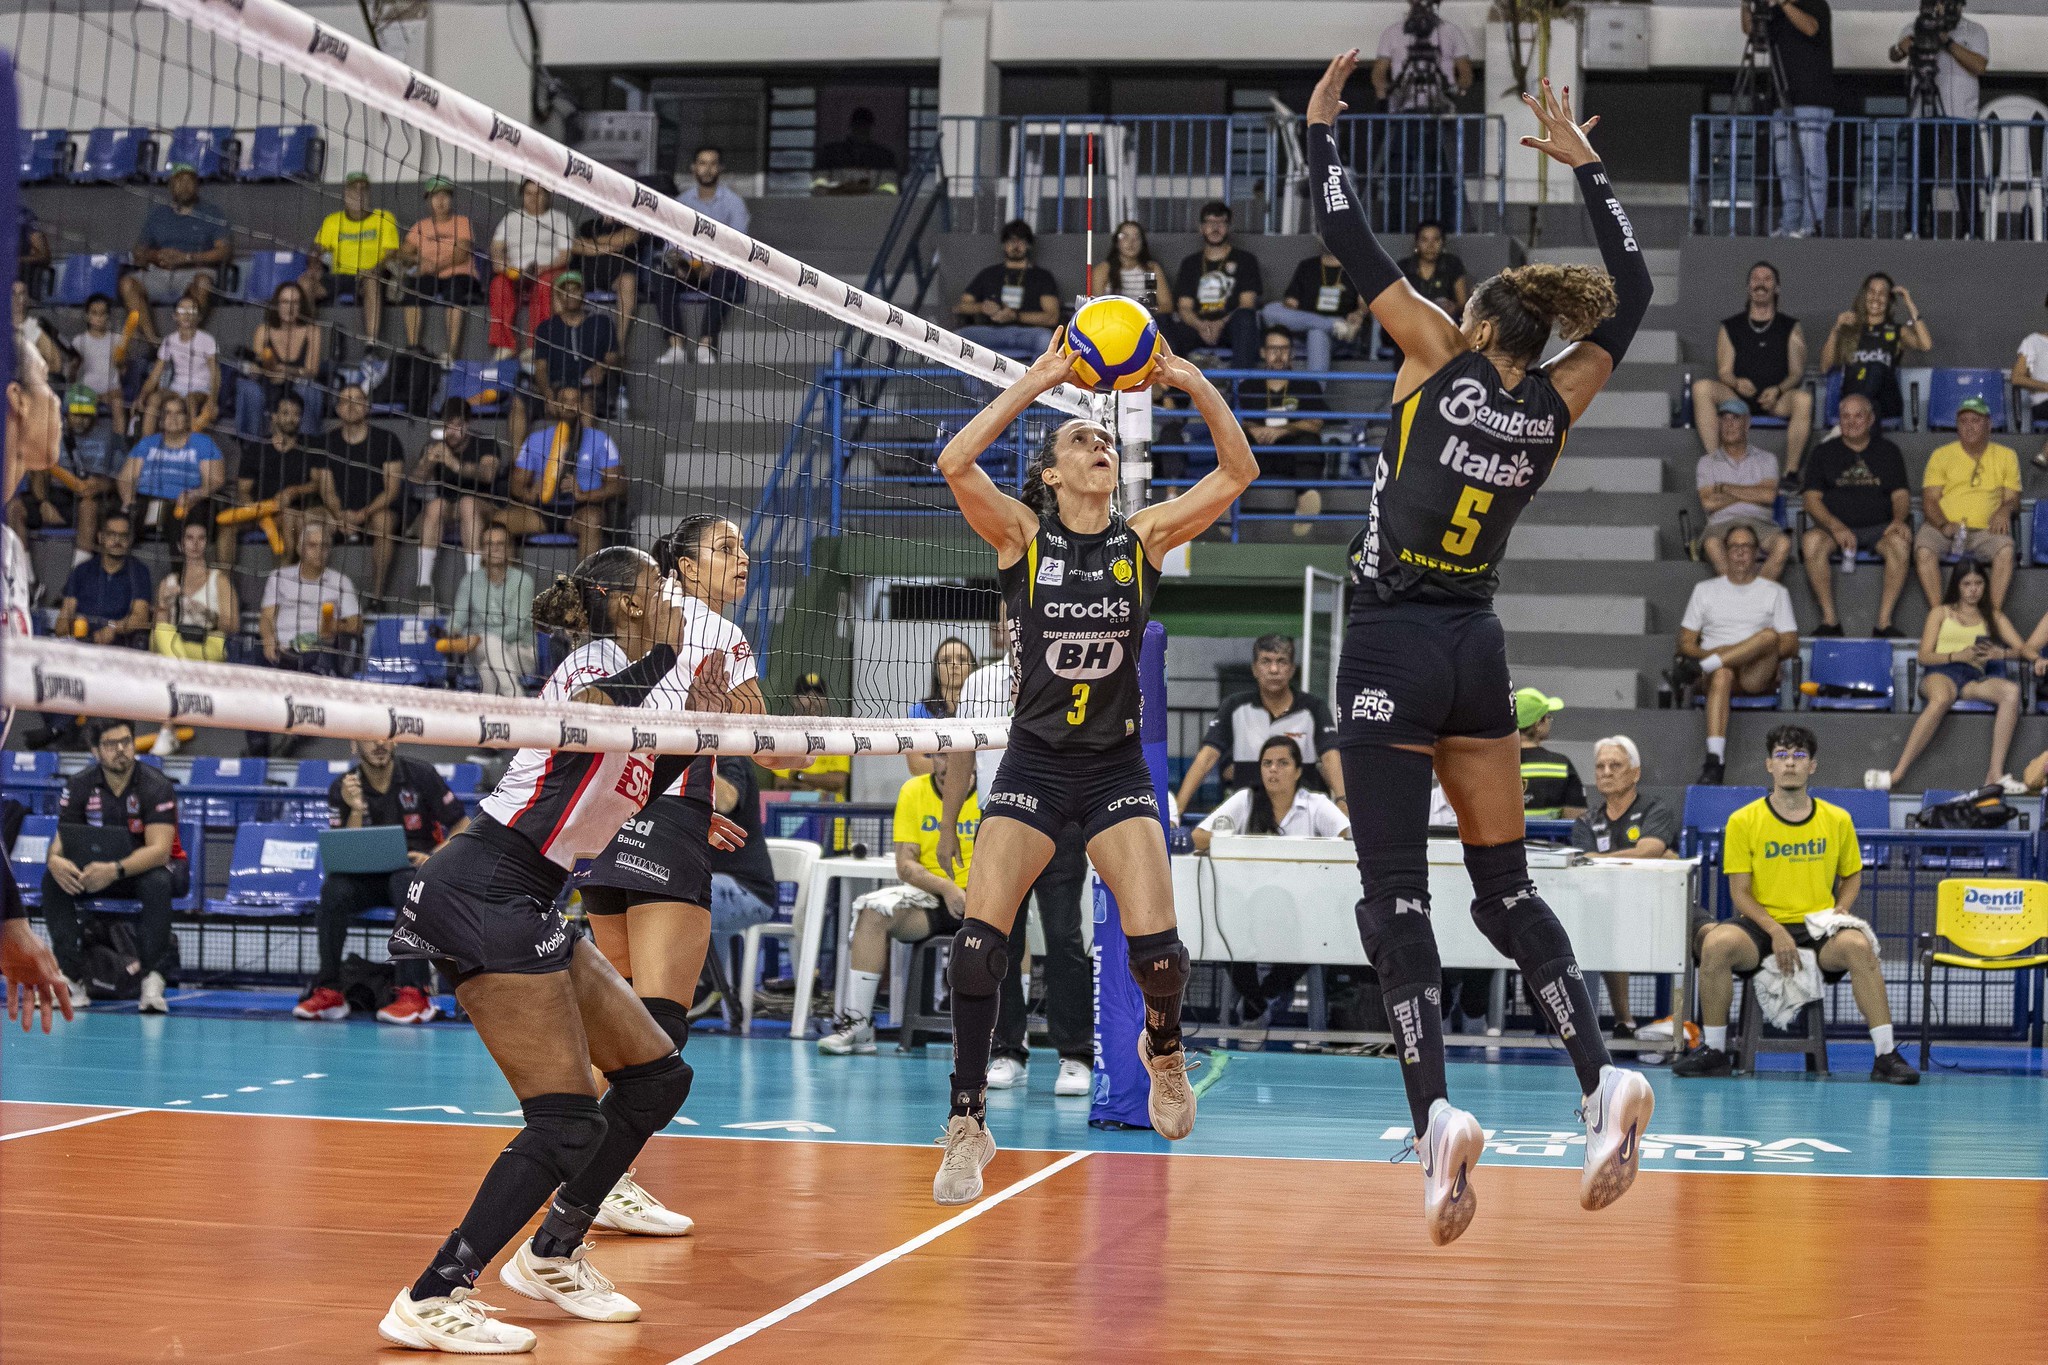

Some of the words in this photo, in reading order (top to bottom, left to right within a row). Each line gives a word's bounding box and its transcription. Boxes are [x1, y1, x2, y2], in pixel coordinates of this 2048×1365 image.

[1328, 165, 1350, 211] Dentil
[1605, 198, 1638, 251] Dentil
[1069, 331, 1092, 355] MIKASA
[1439, 435, 1534, 488] Italac
[1441, 484, 1495, 557] 5
[1044, 597, 1131, 619] crock's
[1043, 629, 1130, 640] SUPERMERCADOS
[1055, 641, 1115, 670] BH
[1066, 683, 1091, 726] 3
[1352, 695, 1395, 714] PRO
[1352, 709, 1393, 723] PLAY
[989, 792, 1039, 810] entil
[618, 834, 646, 849] Bauru
[1765, 838, 1827, 858] Dentil
[1965, 889, 2024, 905] Dentil
[1540, 981, 1577, 1041] Dentil
[1393, 1000, 1420, 1065] Dentil
